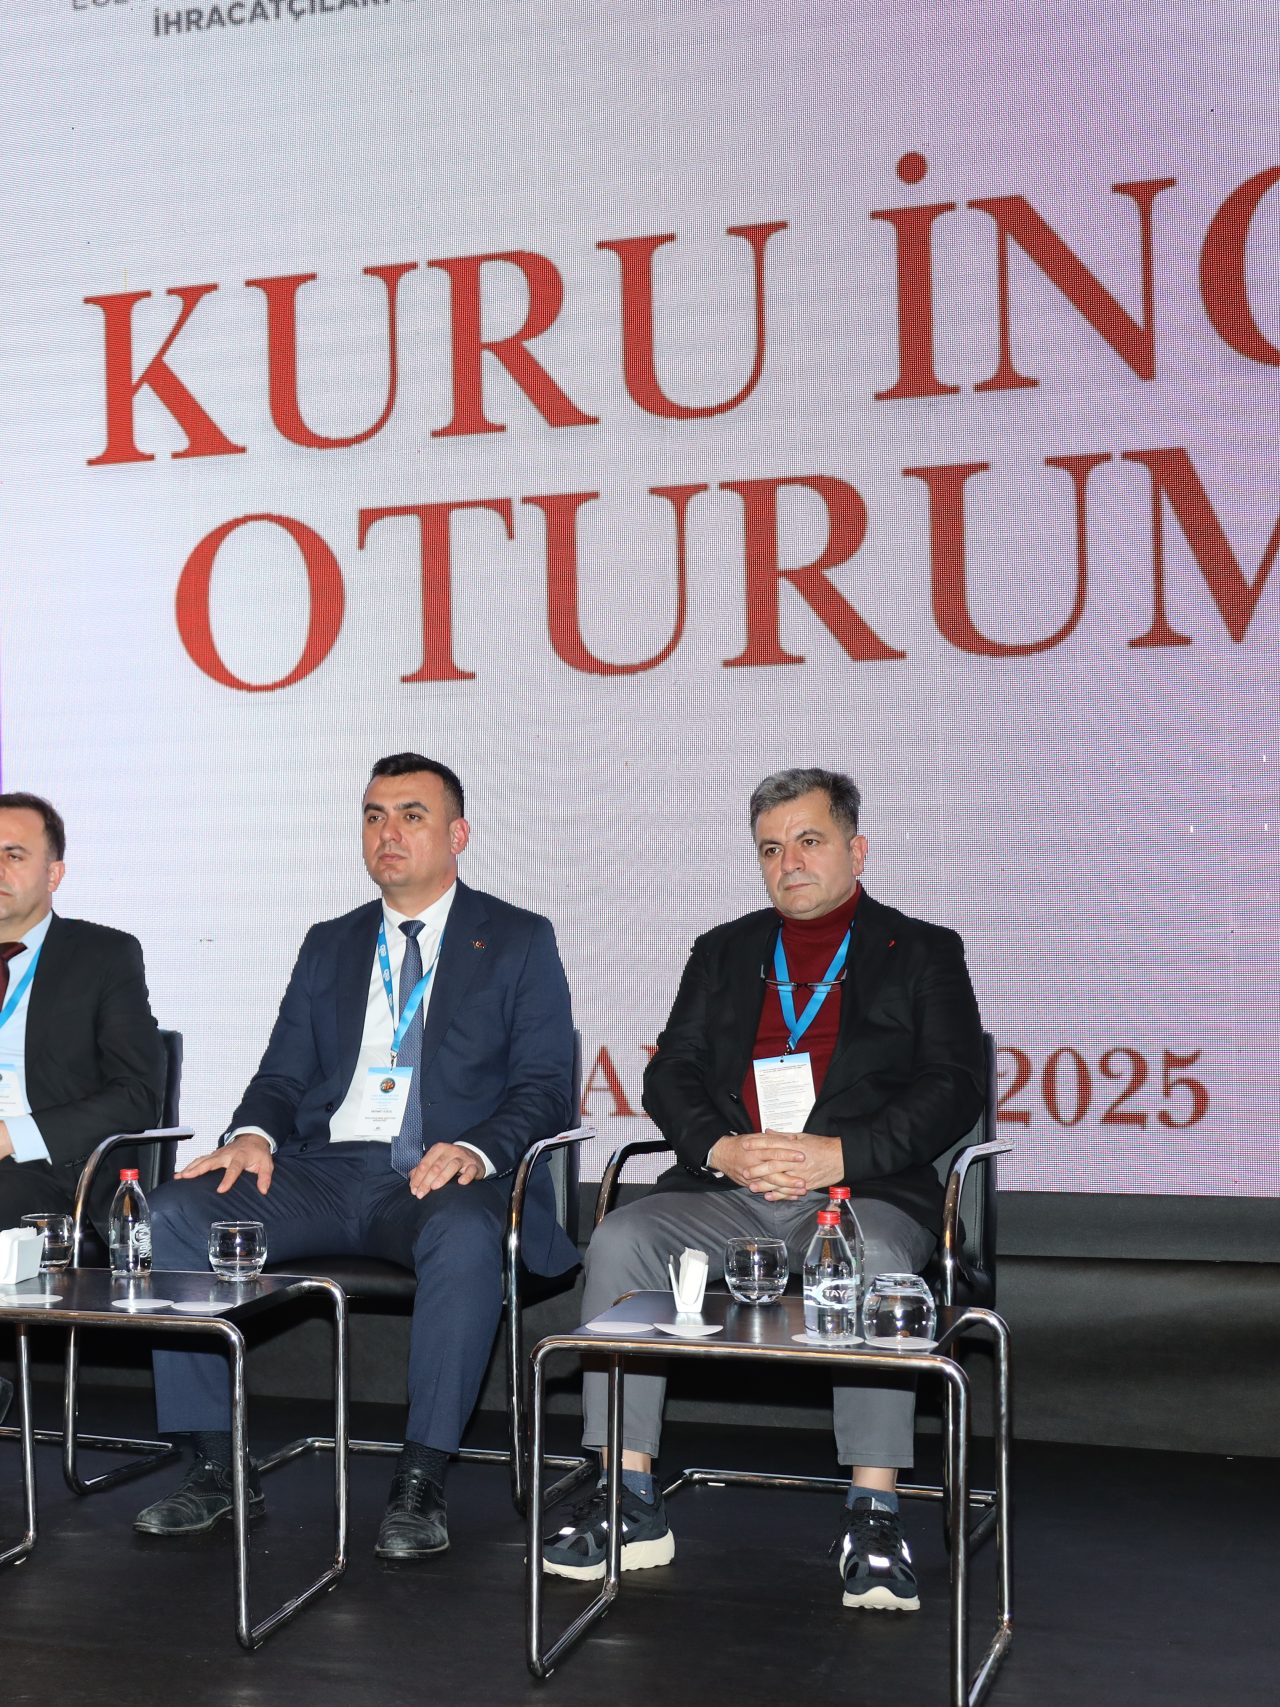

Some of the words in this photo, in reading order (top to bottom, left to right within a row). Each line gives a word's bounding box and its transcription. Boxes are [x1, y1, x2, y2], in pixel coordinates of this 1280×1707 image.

[83, 220, 789, 467] KURU
[174, 447, 1280, 693] OTURUM
[996, 1046, 1210, 1130] 2025
